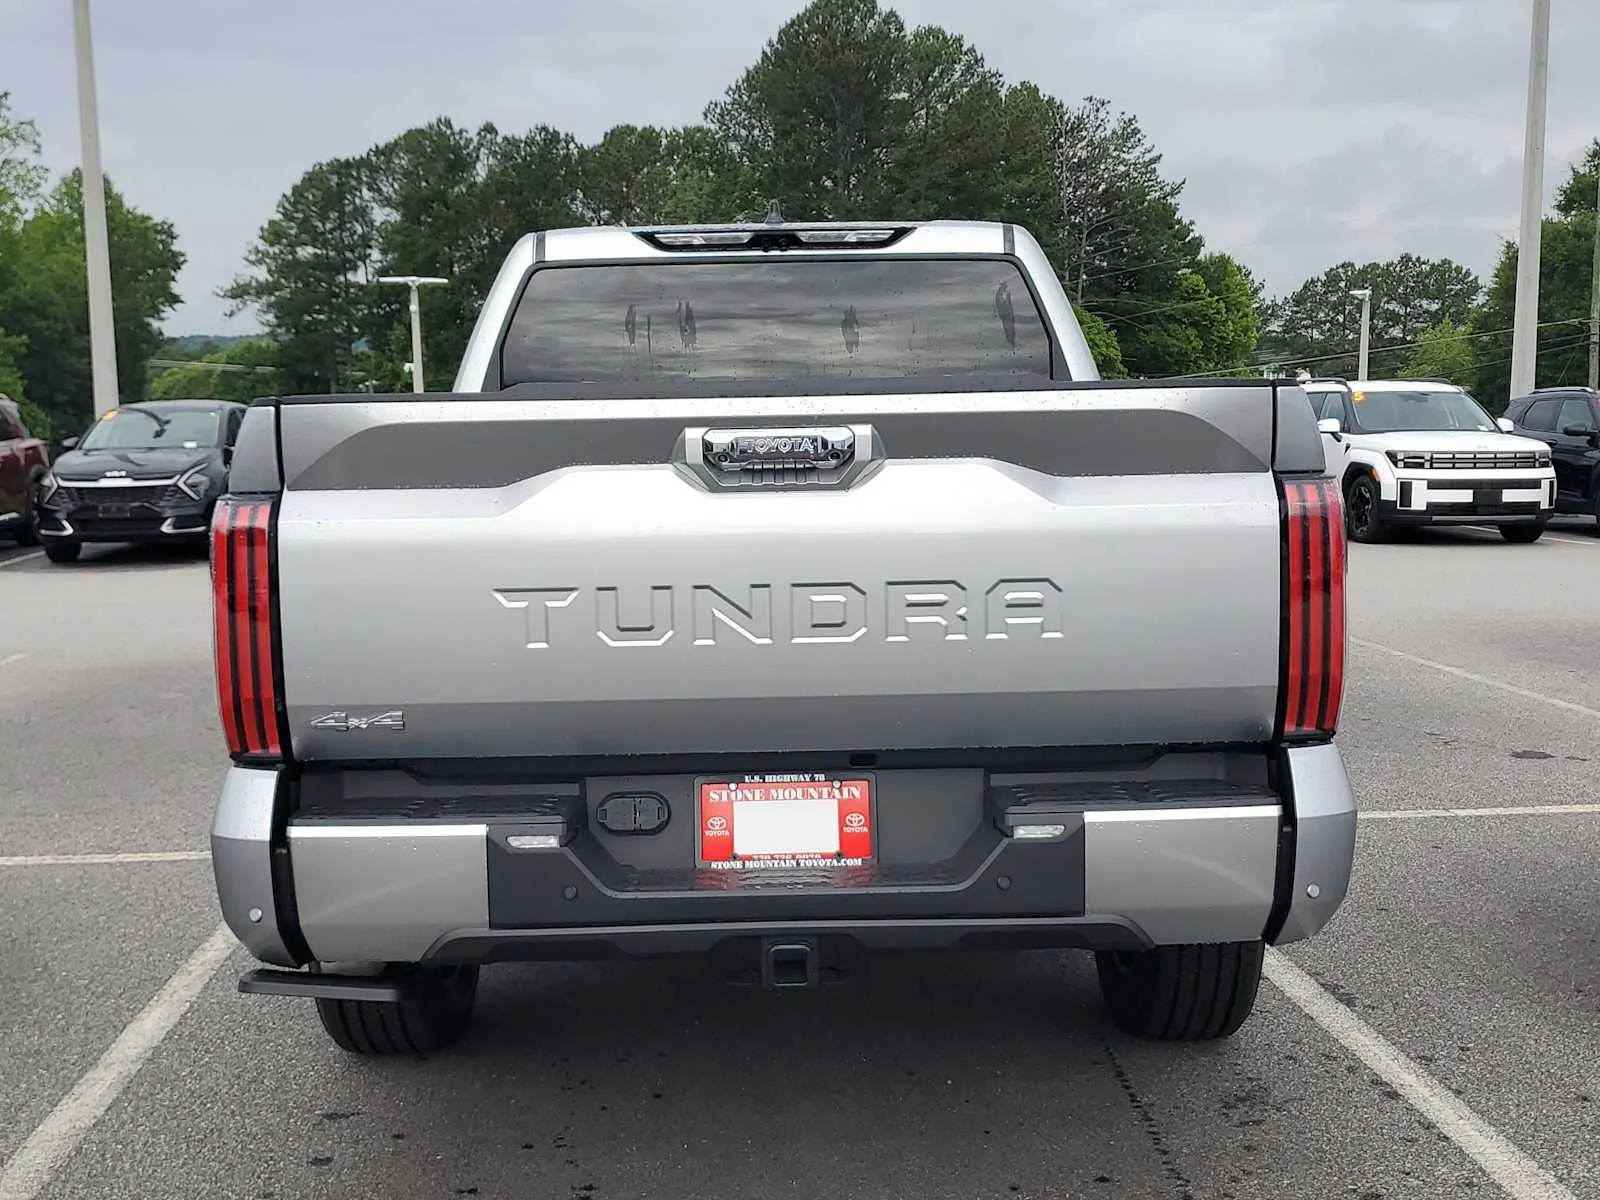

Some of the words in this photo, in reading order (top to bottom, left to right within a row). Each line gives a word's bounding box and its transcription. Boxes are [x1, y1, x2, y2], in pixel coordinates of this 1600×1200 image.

[743, 437, 813, 454] TOYOTA
[493, 578, 1064, 649] TUNDRA
[765, 773, 812, 782] HIGHWAY
[709, 788, 766, 802] STONE
[769, 786, 862, 801] MOUNTAIN
[710, 861, 744, 870] STONE
[745, 859, 797, 869] MOUNTAIN
[798, 858, 863, 868] TOYOTA.COM
